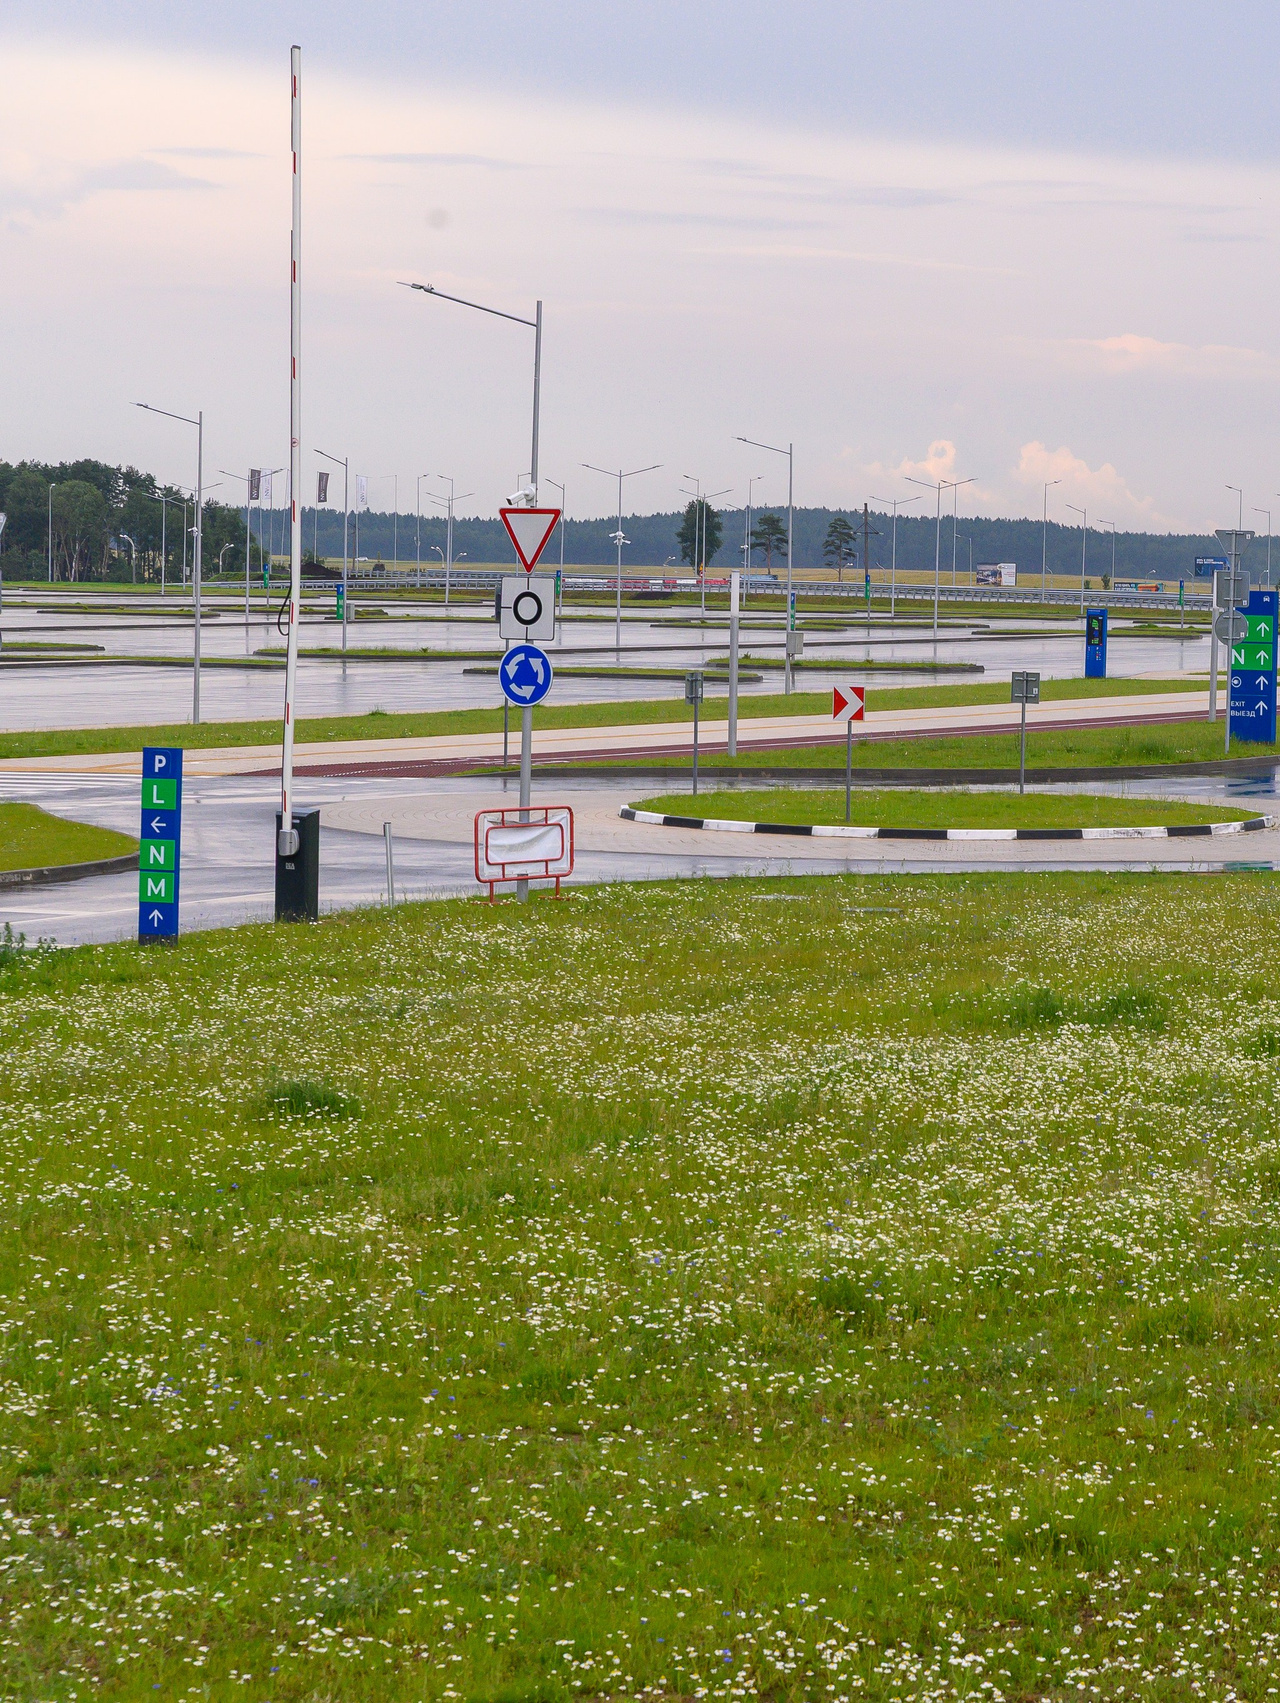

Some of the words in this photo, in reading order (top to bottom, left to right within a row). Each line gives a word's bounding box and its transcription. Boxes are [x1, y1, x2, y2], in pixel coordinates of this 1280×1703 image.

[1231, 648, 1245, 665] N
[1230, 709, 1256, 718] ВЫЕЗД
[154, 754, 167, 773] P
[152, 784, 165, 804] L
[149, 845, 165, 865] N
[147, 877, 166, 897] M
